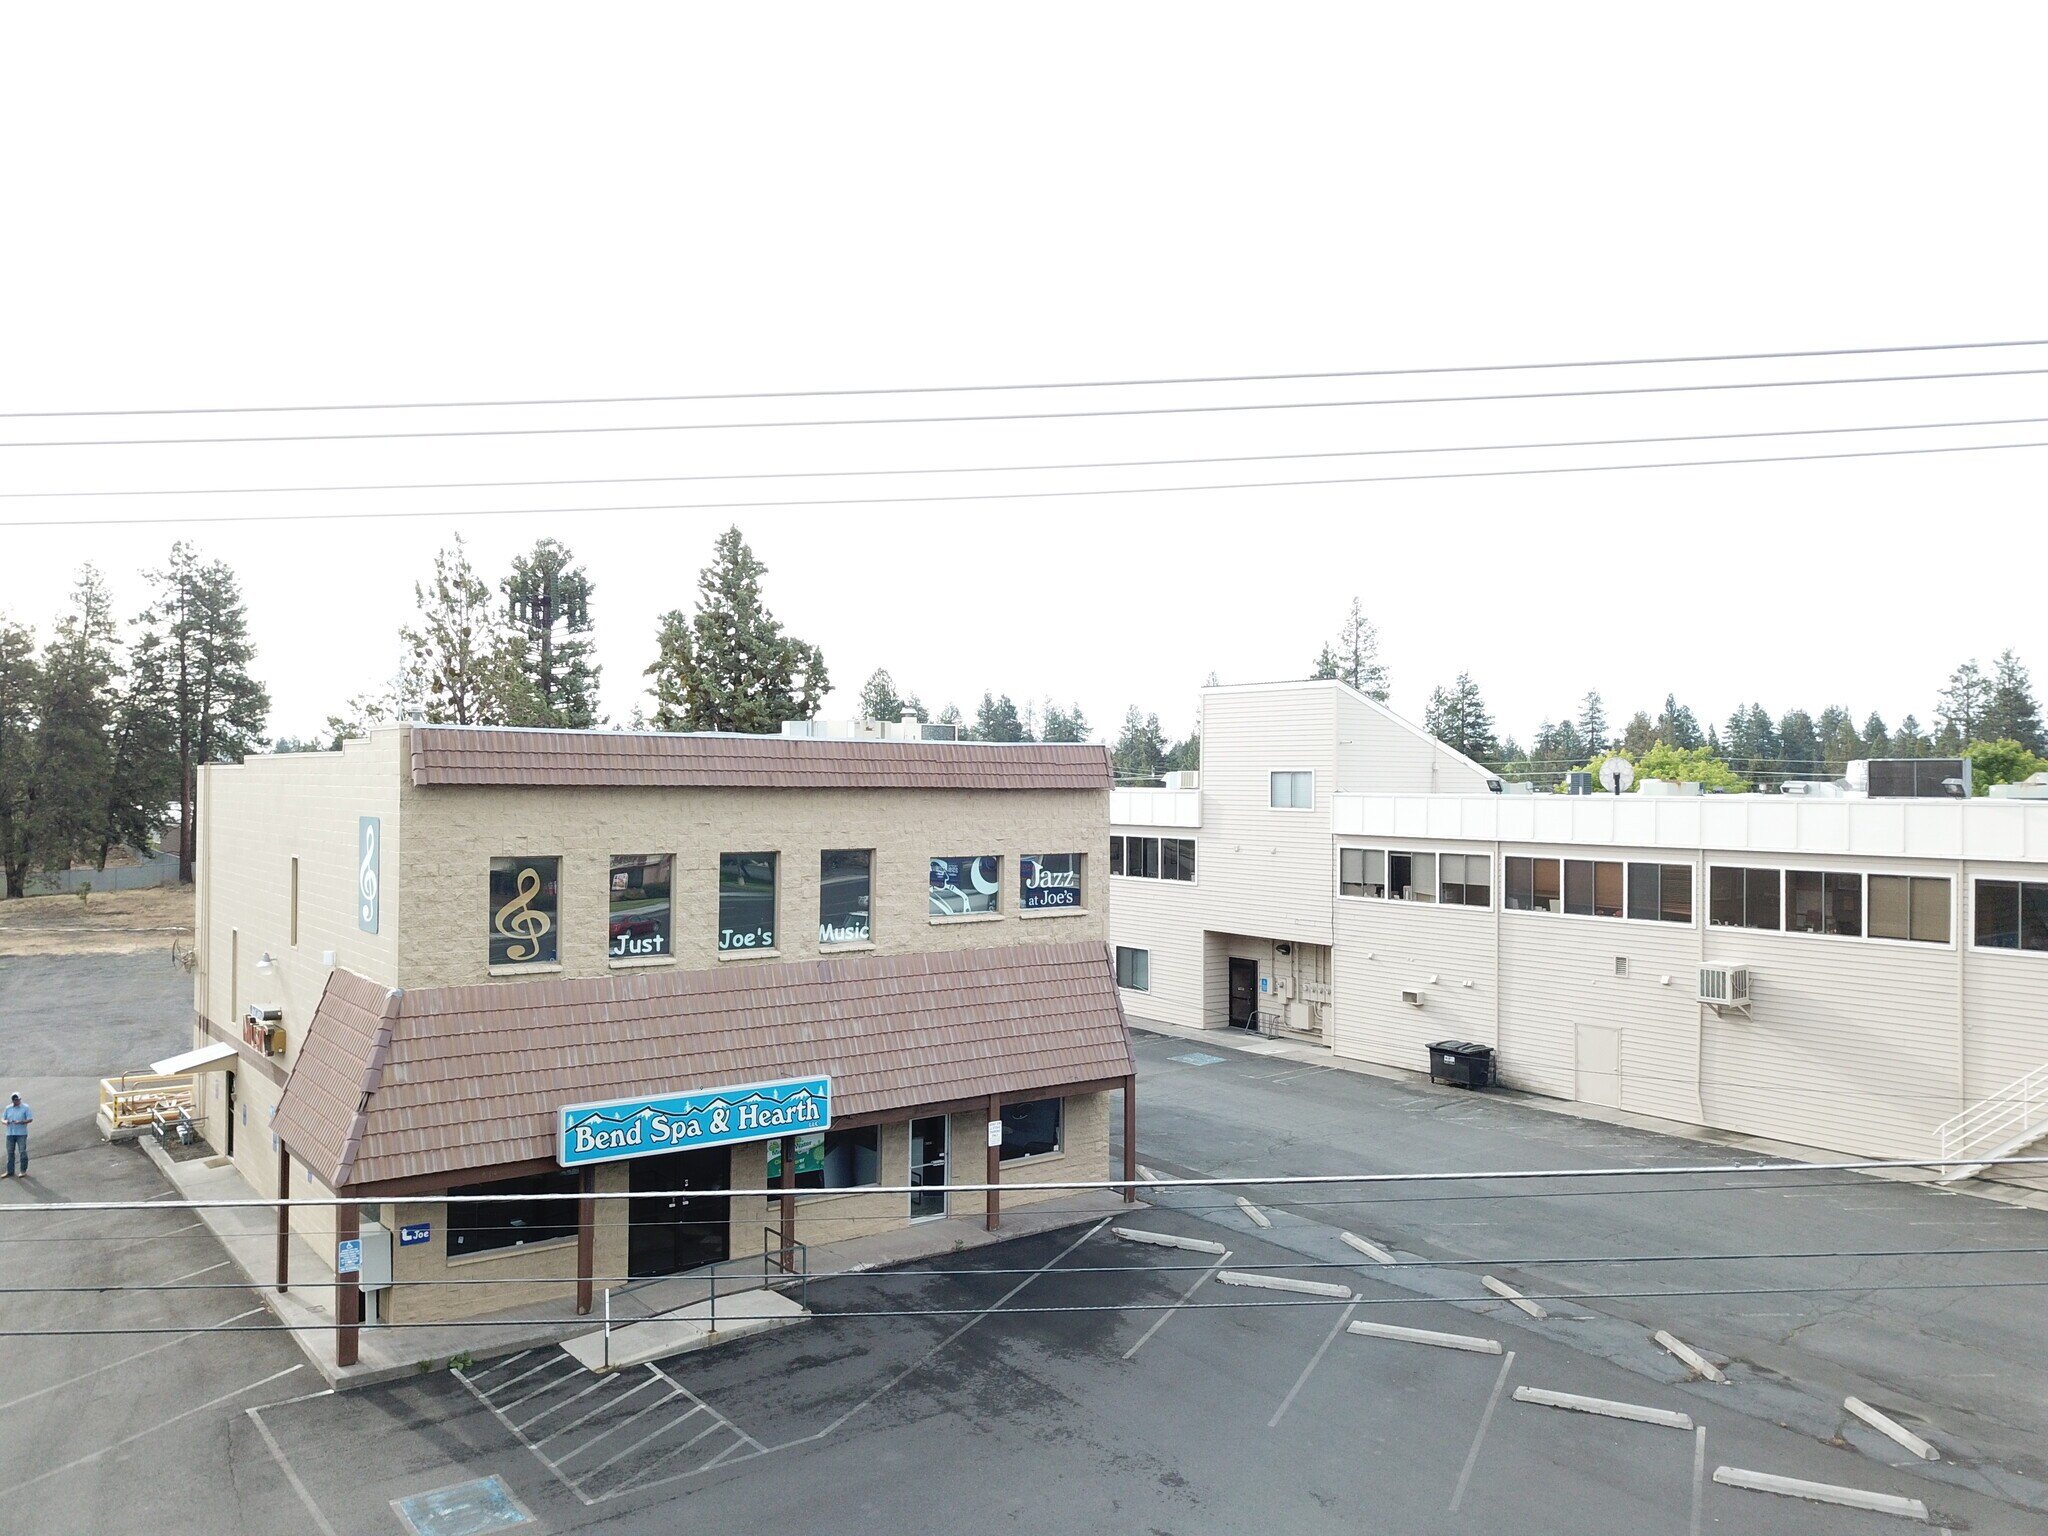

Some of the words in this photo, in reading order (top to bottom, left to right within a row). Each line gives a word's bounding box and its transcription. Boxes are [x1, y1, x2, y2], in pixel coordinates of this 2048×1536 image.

[1026, 860, 1074, 888] Jazz
[1028, 895, 1039, 906] at
[1040, 889, 1073, 905] Joe's
[613, 934, 664, 955] Just
[719, 927, 772, 949] Joe's
[819, 922, 870, 941] Music
[574, 1118, 642, 1153] Bend
[650, 1113, 703, 1145] Spa
[709, 1107, 731, 1135] &
[738, 1096, 820, 1130] Hearth
[413, 1229, 430, 1240] Joe
